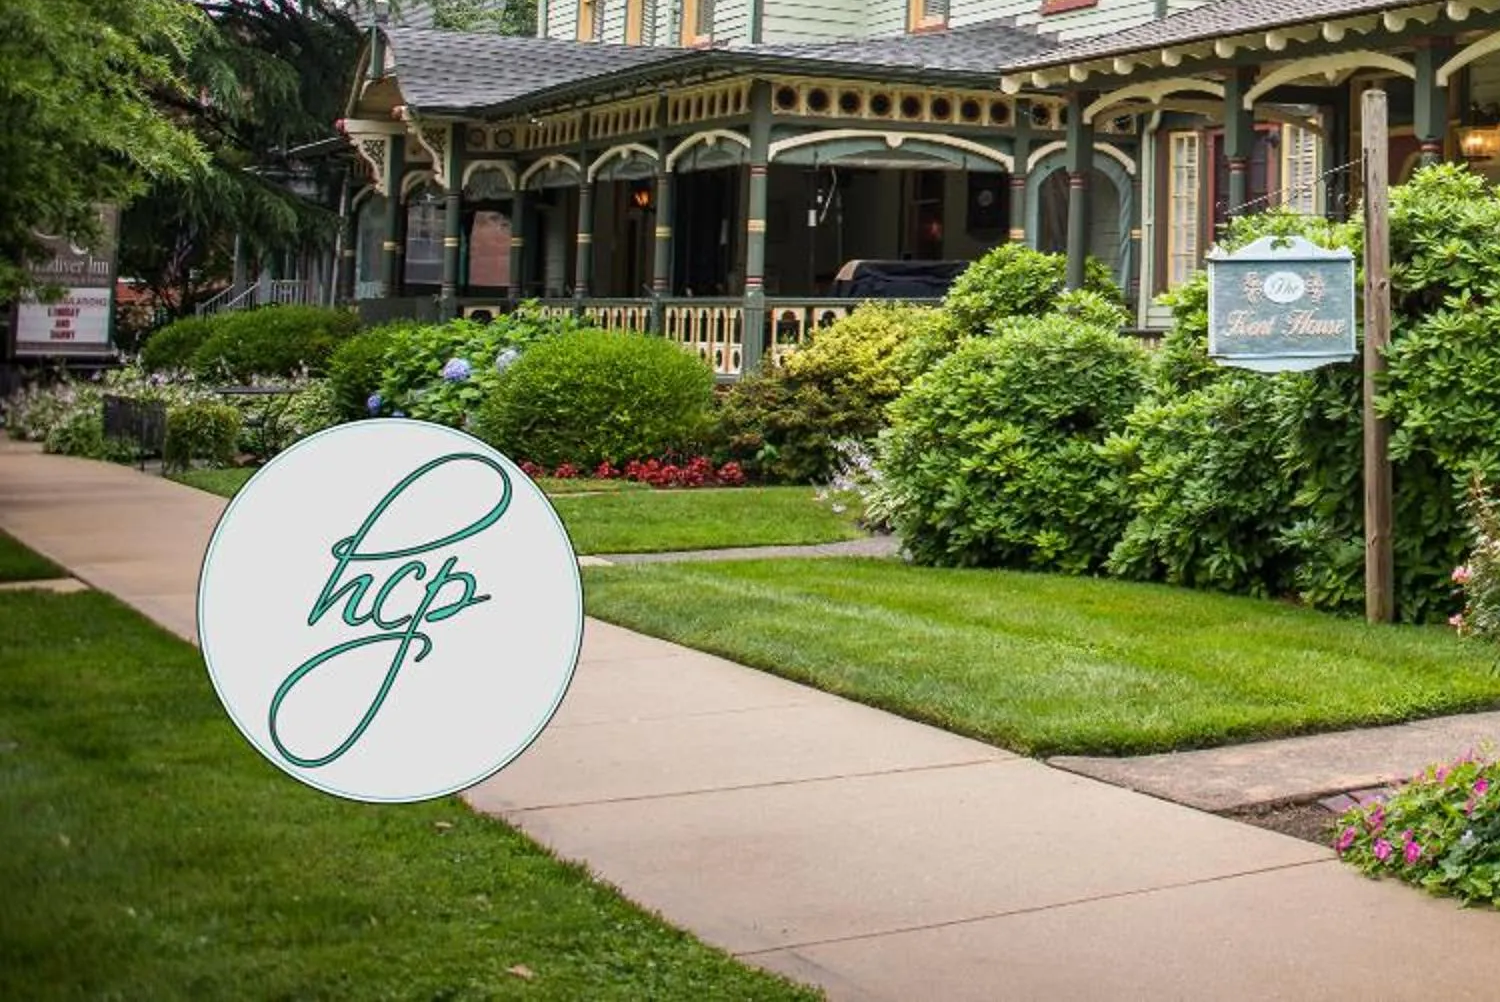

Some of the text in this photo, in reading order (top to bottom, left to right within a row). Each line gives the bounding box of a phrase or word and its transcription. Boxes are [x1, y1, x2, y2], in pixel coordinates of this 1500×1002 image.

[89, 256, 109, 274] Inn
[1269, 277, 1299, 295] The
[1281, 308, 1345, 336] House
